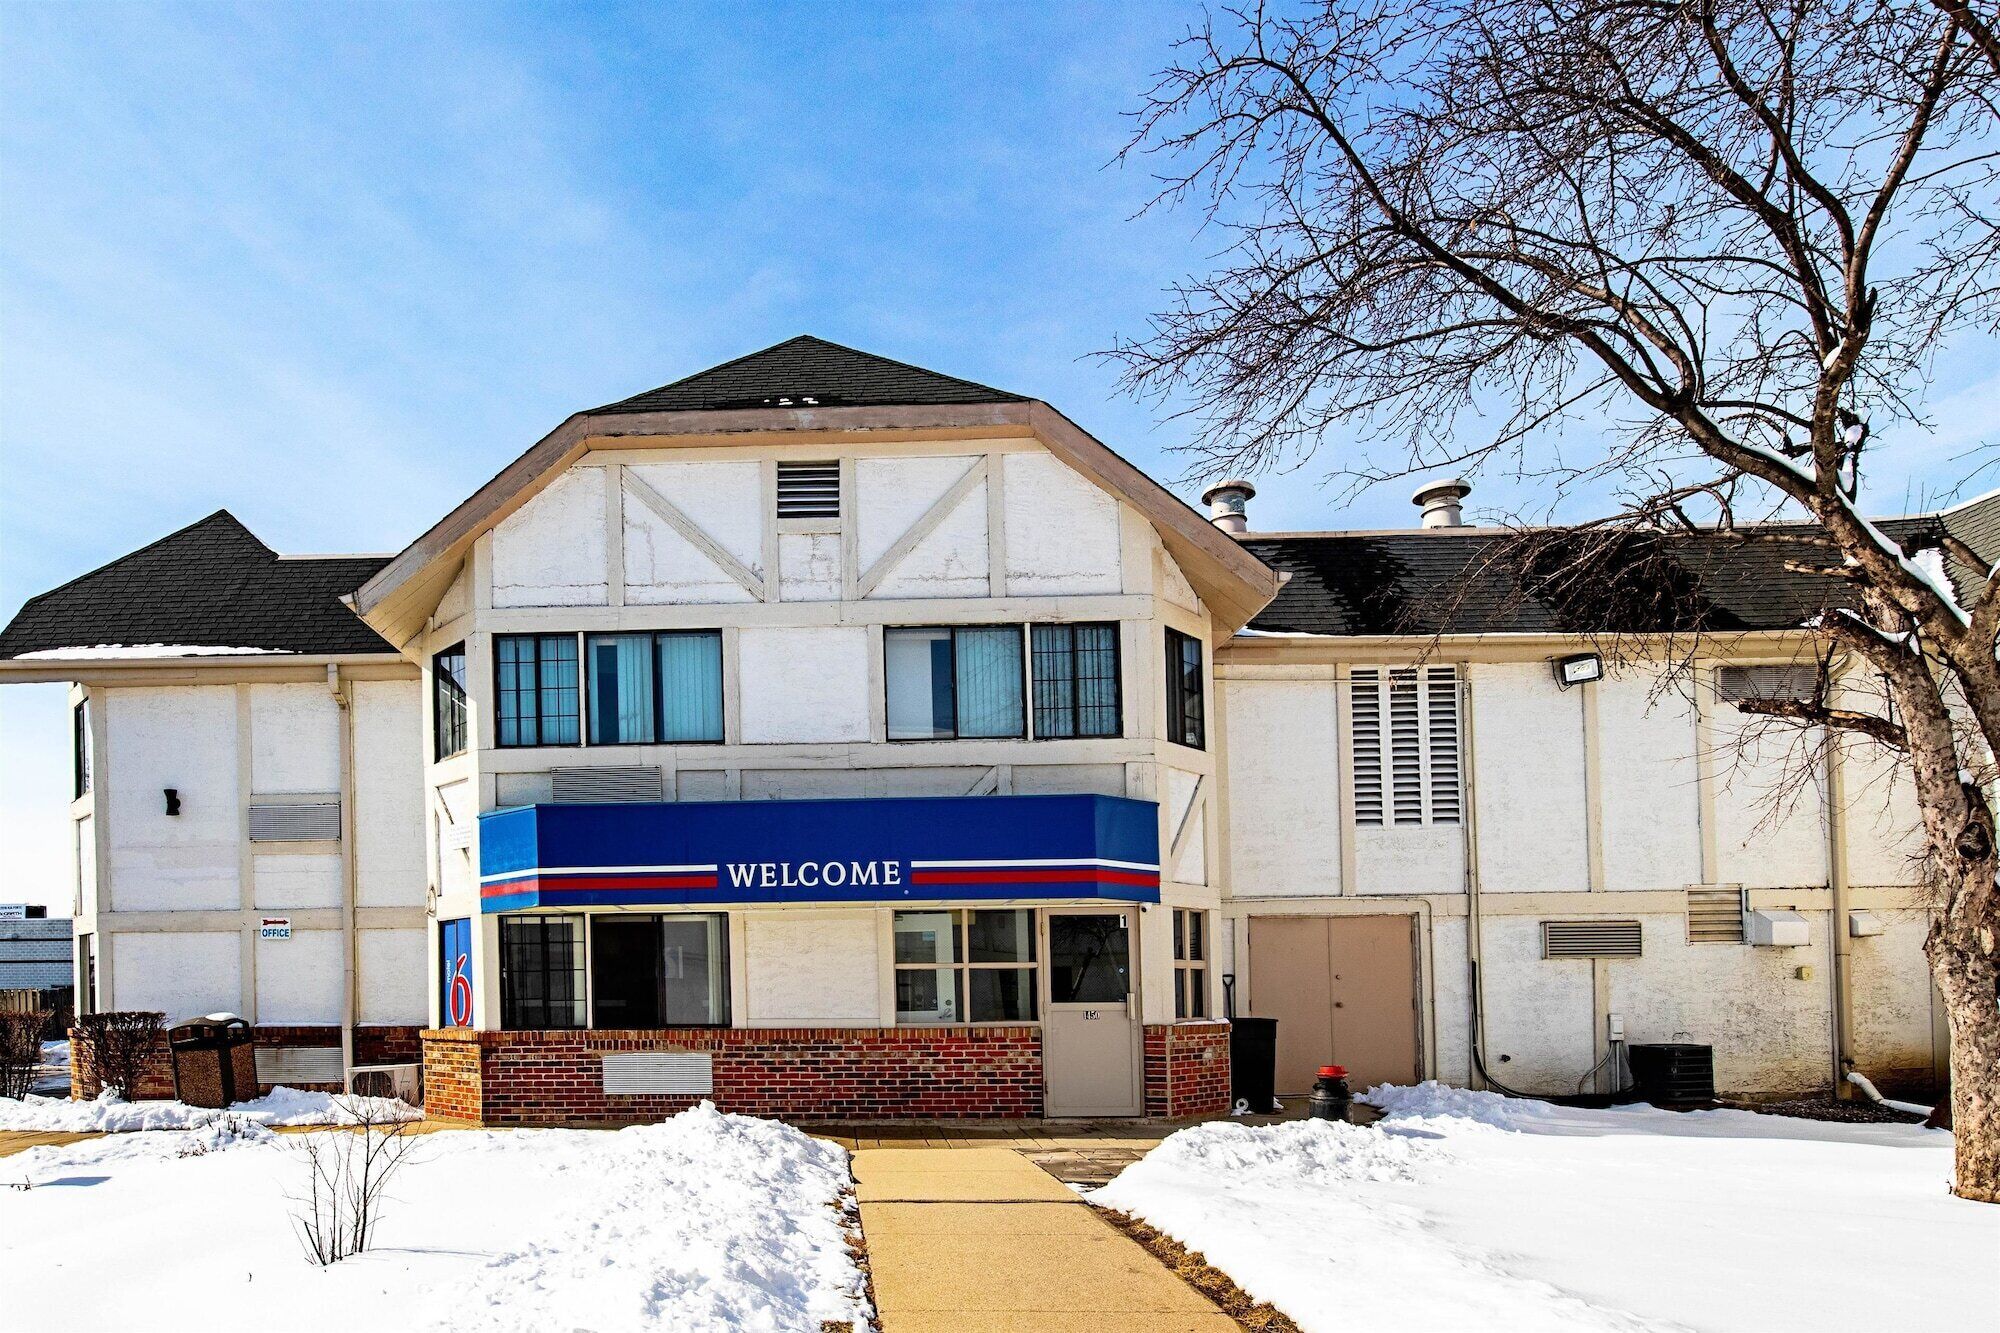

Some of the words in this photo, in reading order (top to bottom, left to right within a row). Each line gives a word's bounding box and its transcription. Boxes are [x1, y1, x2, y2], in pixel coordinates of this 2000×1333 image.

[726, 860, 902, 888] WELCOME
[1121, 914, 1127, 928] 1
[262, 928, 290, 938] OFFICE
[450, 953, 473, 1028] 6
